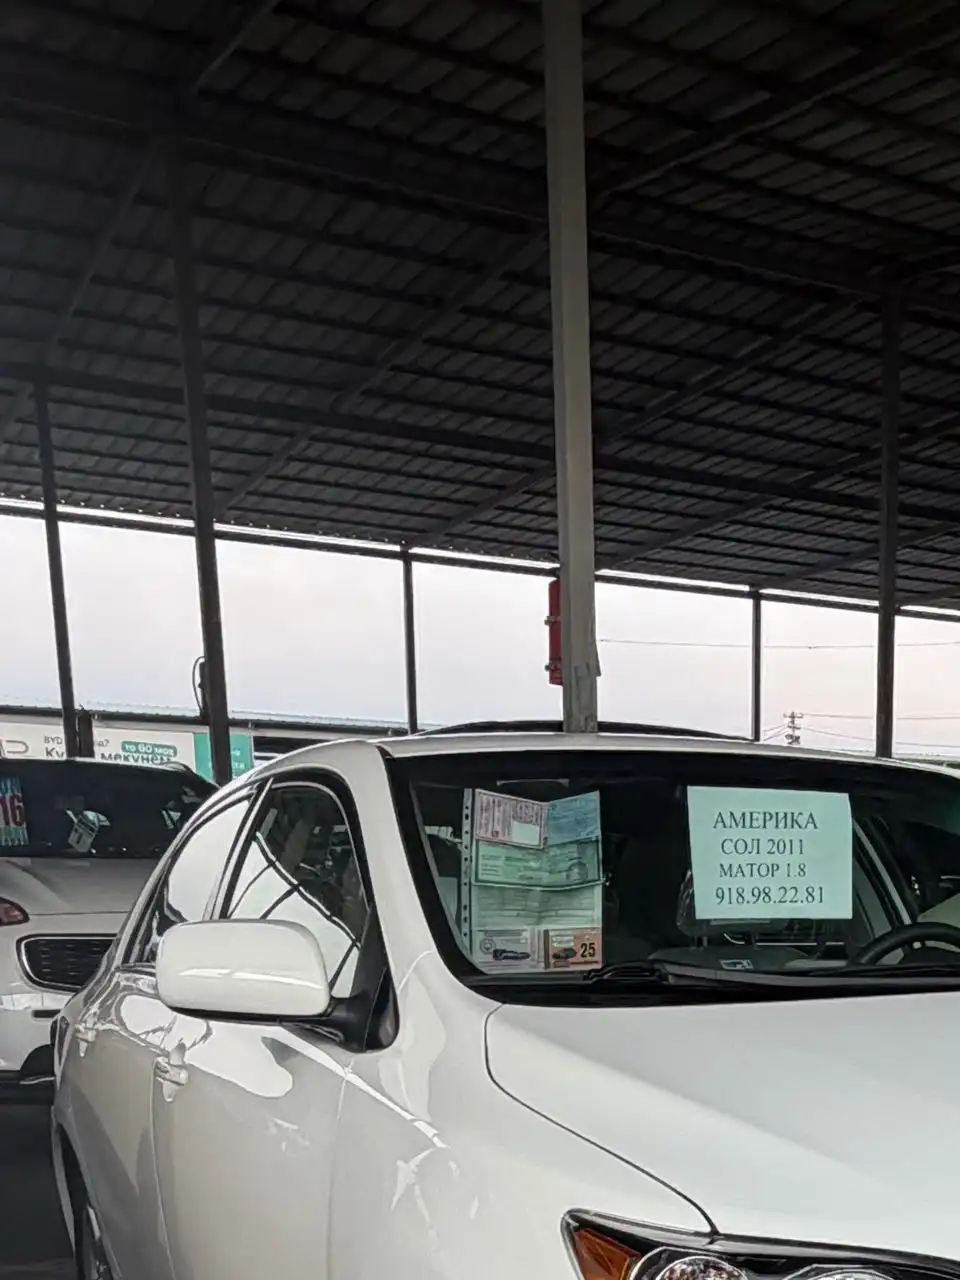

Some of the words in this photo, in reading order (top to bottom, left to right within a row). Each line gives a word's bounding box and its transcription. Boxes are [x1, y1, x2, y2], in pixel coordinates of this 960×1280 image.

[713, 811, 819, 830] АМЕРИКА
[721, 838, 761, 855] СОЛ
[766, 838, 805, 855] 2011
[719, 862, 780, 878] МАТОР
[786, 862, 807, 878] 1.8
[715, 886, 825, 905] 918.98.22.81
[580, 942, 596, 958] 25
